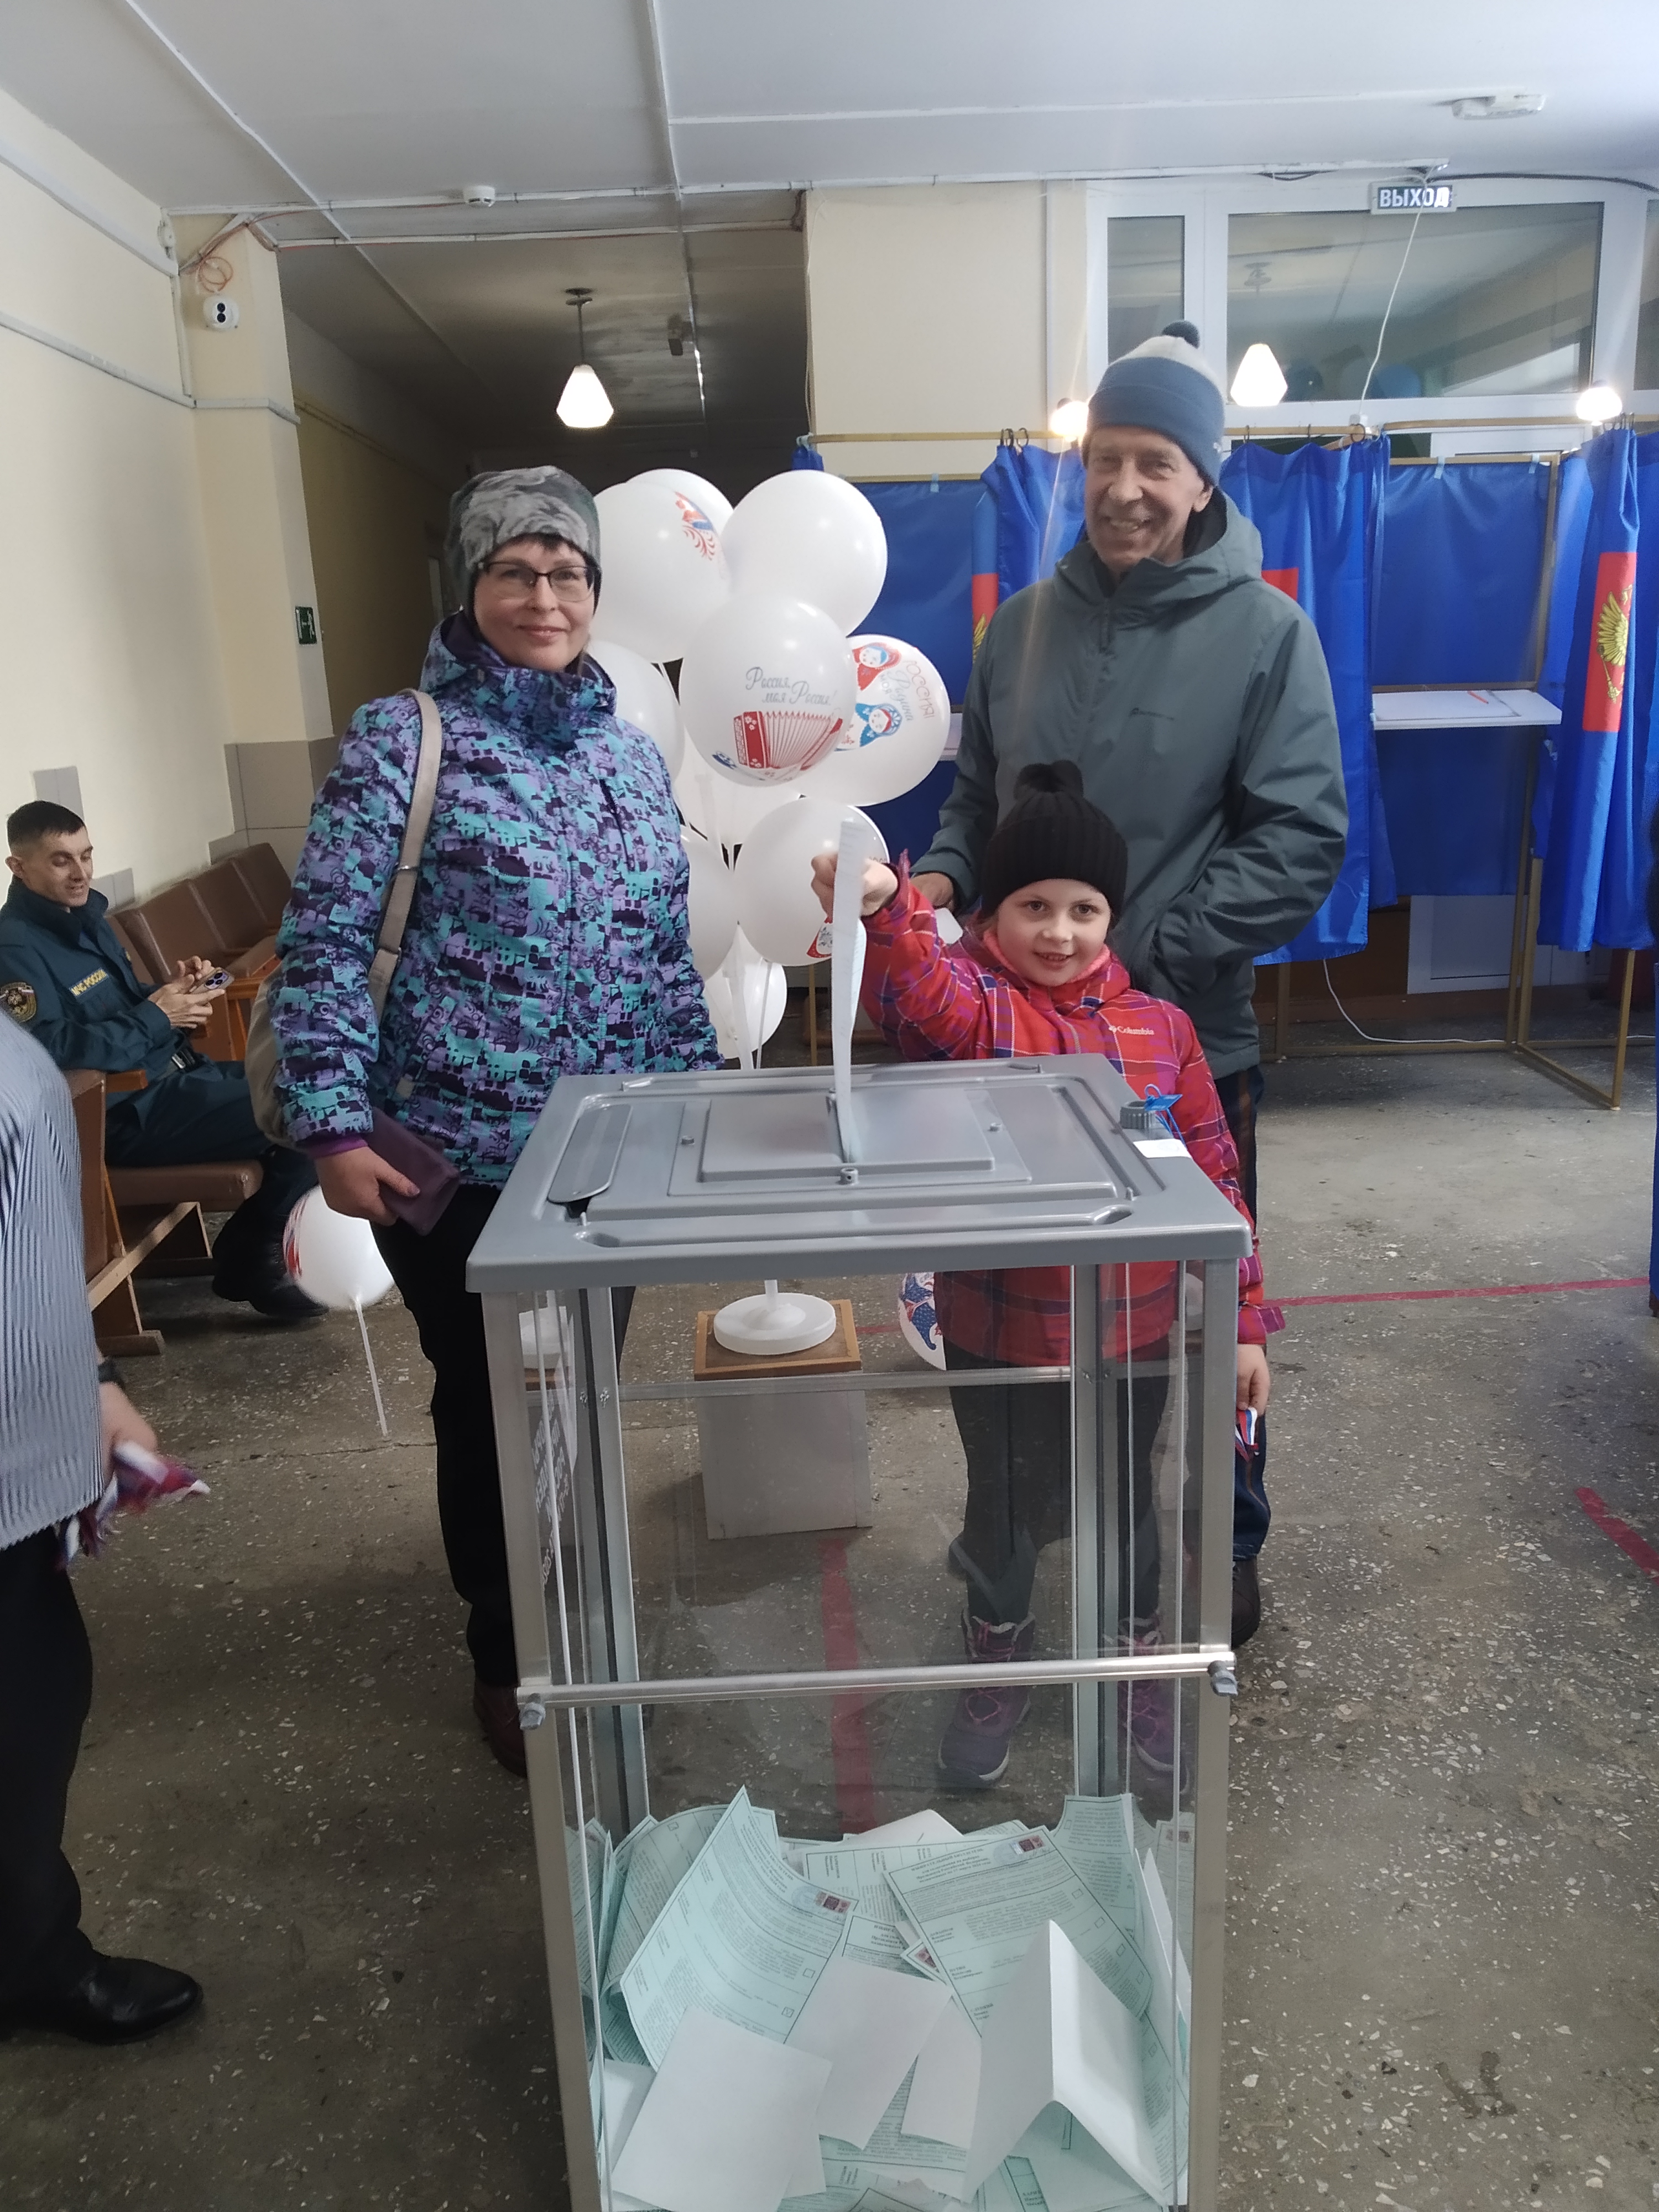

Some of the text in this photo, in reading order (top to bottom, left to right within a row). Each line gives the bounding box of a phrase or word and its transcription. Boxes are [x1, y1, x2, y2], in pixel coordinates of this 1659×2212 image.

[1380, 187, 1450, 207] ВЫХОД
[761, 692, 786, 703] моя
[71, 982, 87, 996] МЧС
[1117, 1025, 1154, 1035] Columbia
